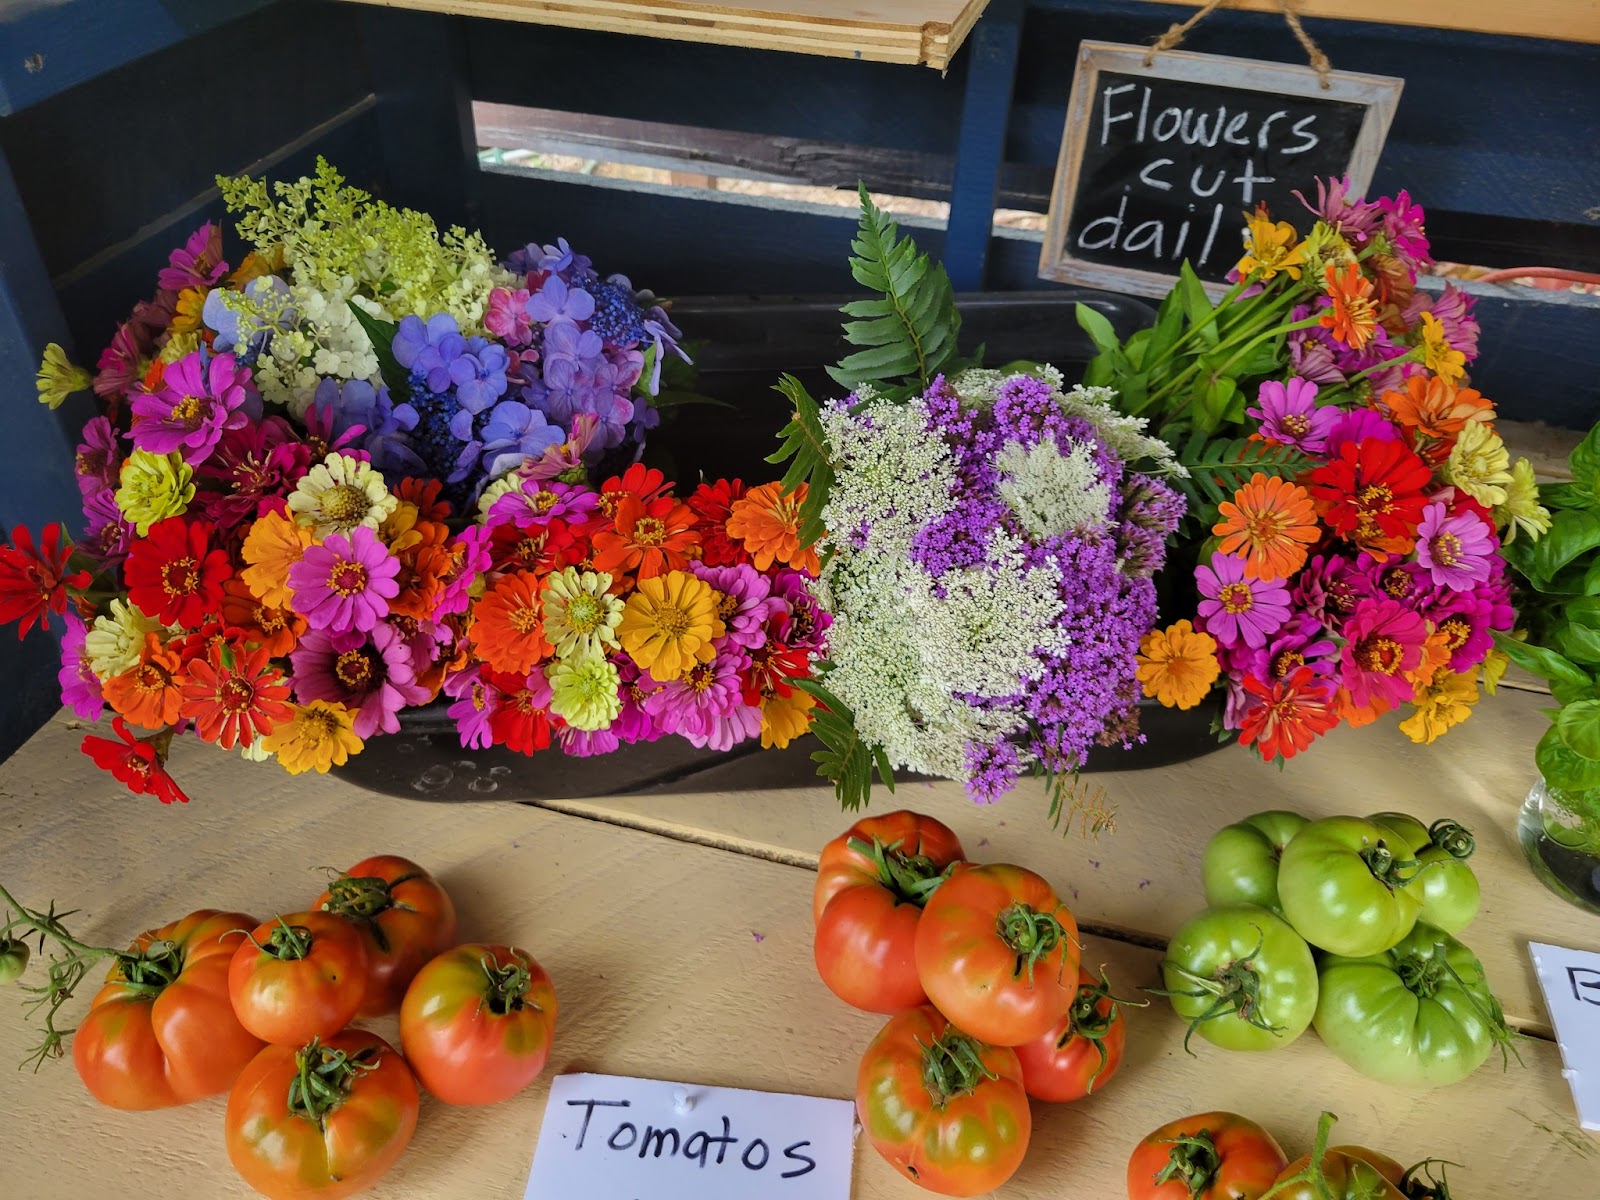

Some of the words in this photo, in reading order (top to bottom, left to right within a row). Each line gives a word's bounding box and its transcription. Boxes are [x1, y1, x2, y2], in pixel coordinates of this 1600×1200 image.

[1101, 83, 1319, 155] Flowers
[1139, 158, 1275, 203] cut
[1077, 187, 1253, 275] dail
[567, 1099, 816, 1178] Tomatos
